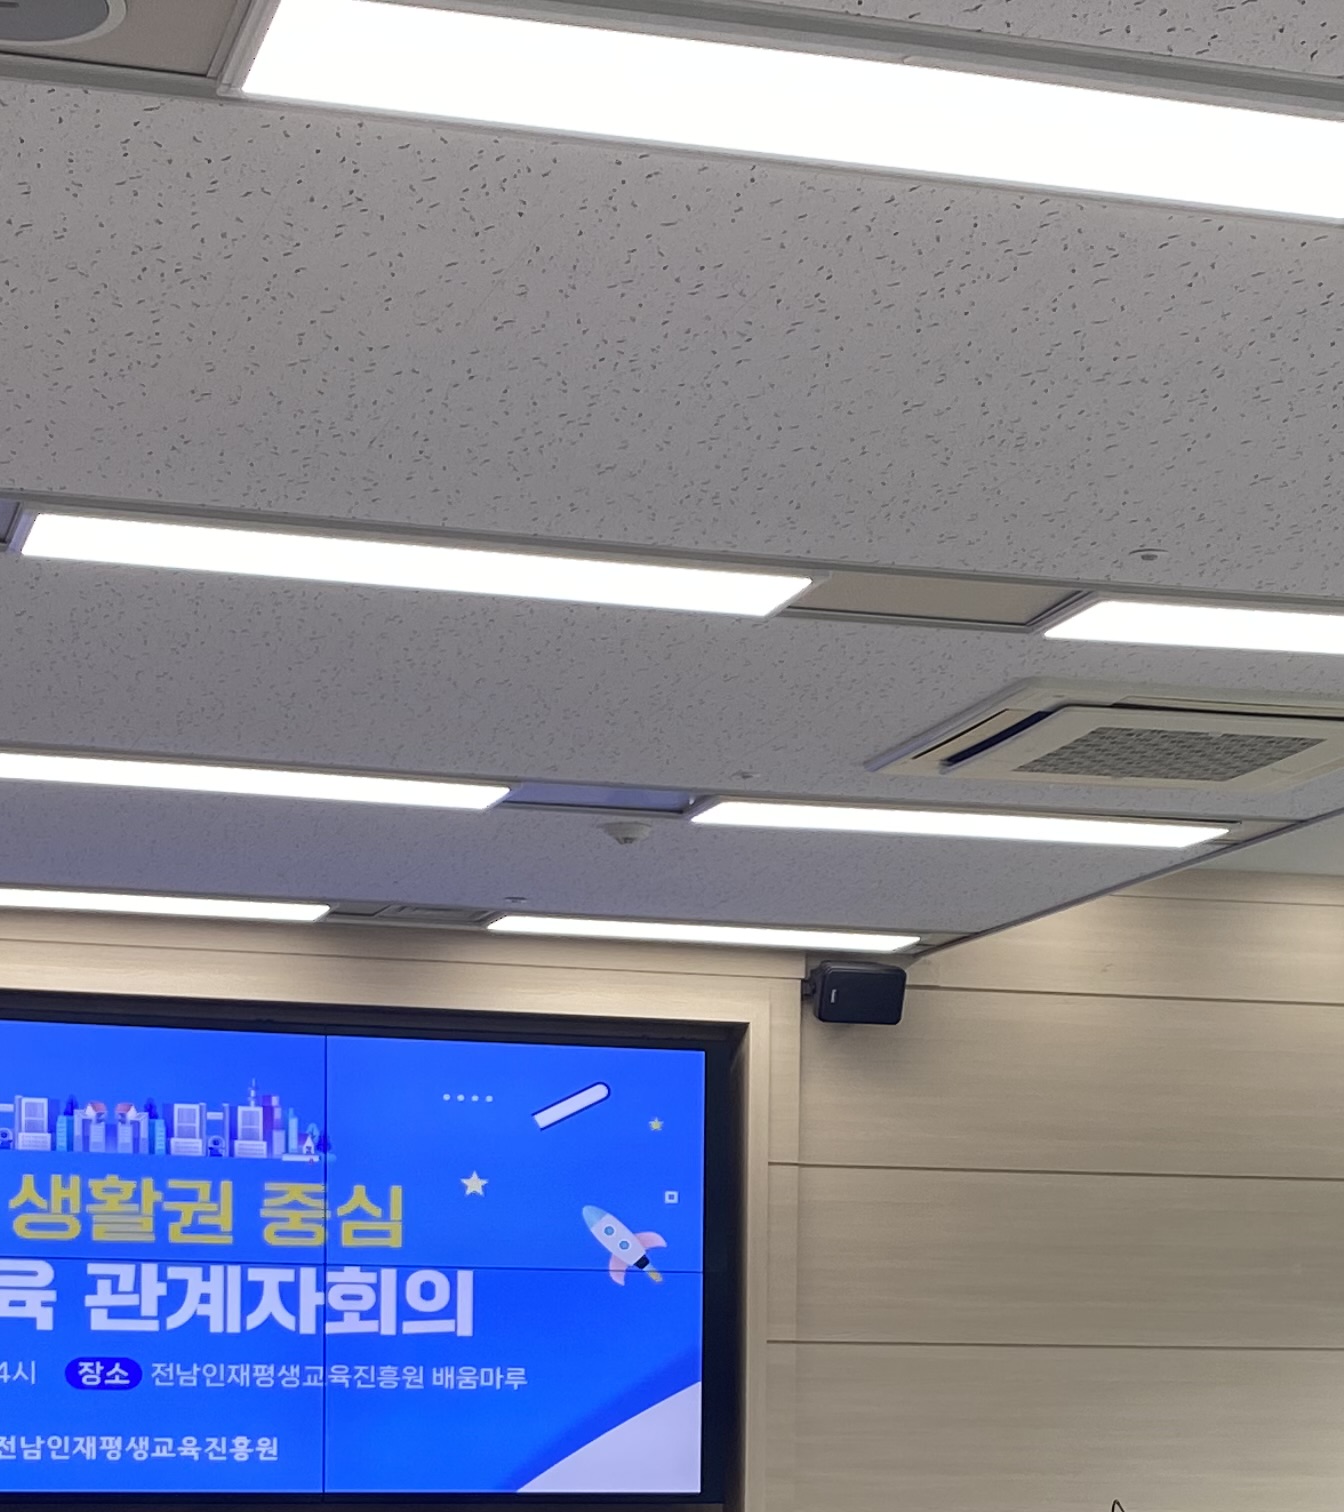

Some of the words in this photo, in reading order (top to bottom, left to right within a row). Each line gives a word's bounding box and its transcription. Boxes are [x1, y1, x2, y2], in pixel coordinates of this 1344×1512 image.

[8, 1173, 235, 1245] 생활권
[260, 1181, 404, 1249] 중심
[84, 1262, 474, 1337] 관계자회의
[77, 1361, 131, 1386] 장소
[151, 1362, 425, 1390] 전남인재평생교육진흥원
[432, 1366, 529, 1391] 배움마루
